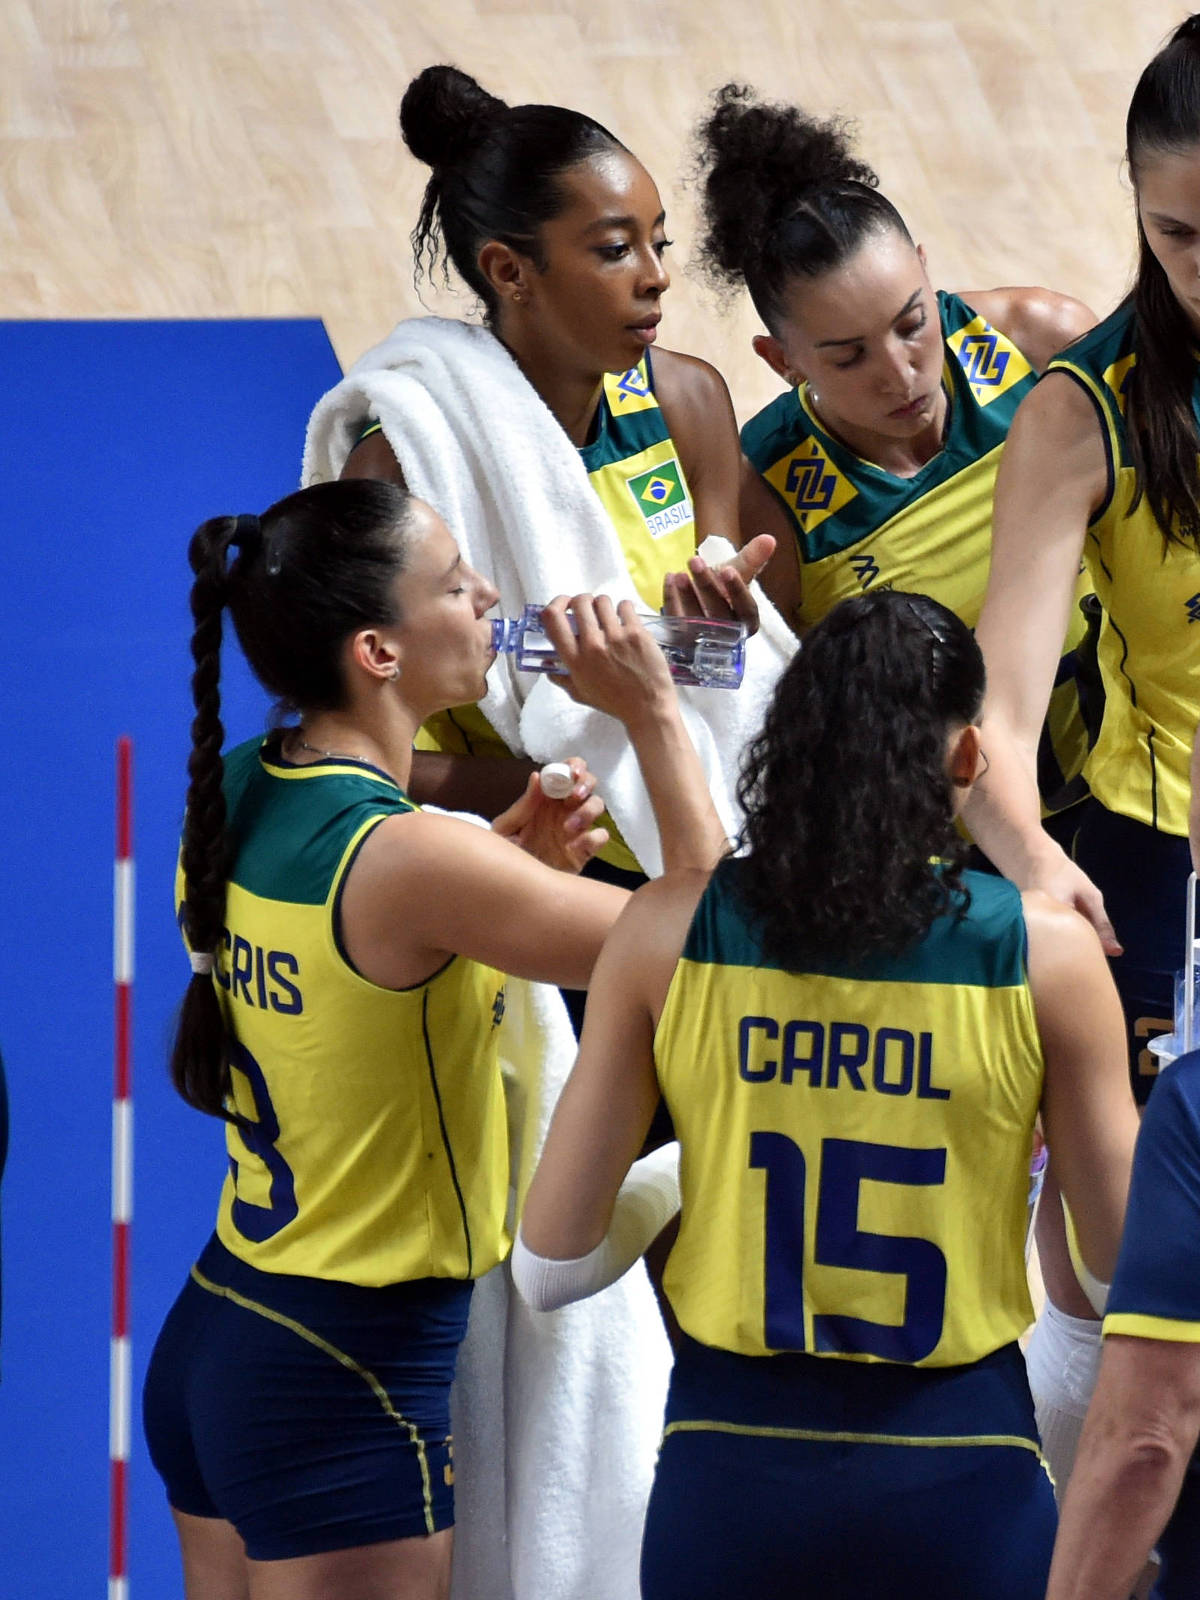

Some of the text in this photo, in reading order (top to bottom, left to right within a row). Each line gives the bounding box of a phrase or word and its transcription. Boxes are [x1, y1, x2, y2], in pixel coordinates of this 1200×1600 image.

[646, 503, 692, 536] BRASIL
[738, 1015, 951, 1101] CAROL
[748, 1131, 948, 1364] 15
